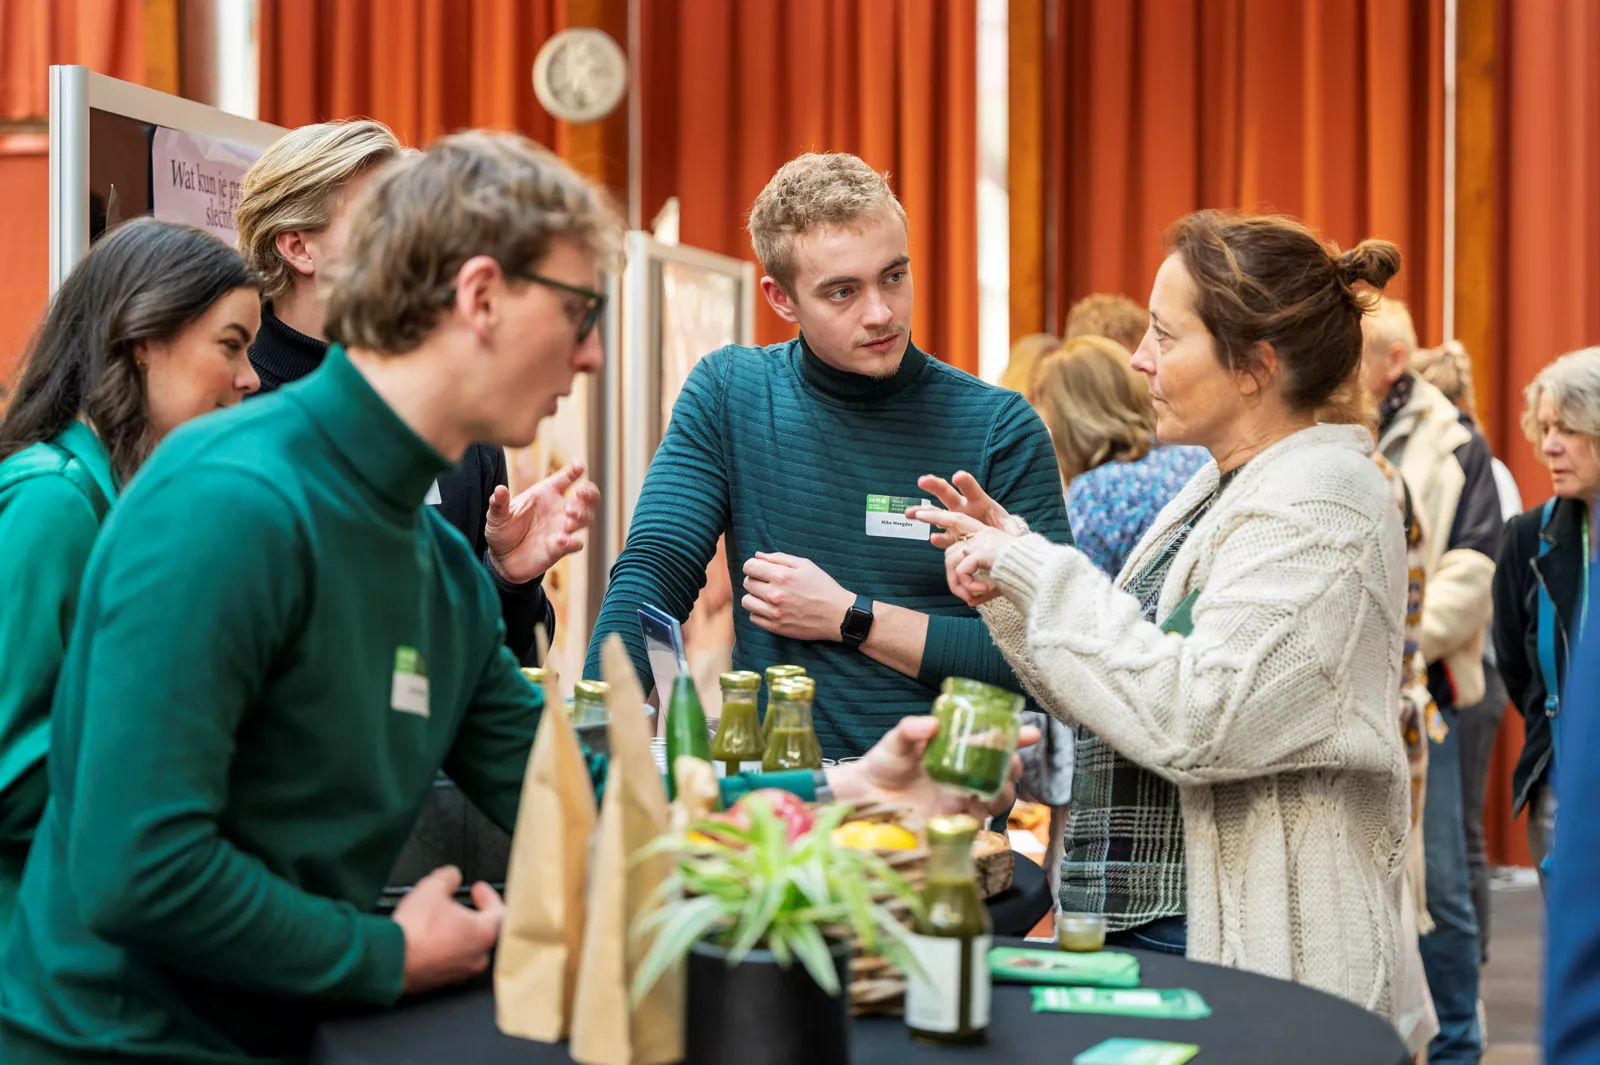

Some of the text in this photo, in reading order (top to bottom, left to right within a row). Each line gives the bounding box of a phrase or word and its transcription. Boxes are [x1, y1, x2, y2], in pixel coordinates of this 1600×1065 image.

[171, 159, 195, 191] Wat
[196, 163, 216, 195] kun
[217, 170, 227, 205] je
